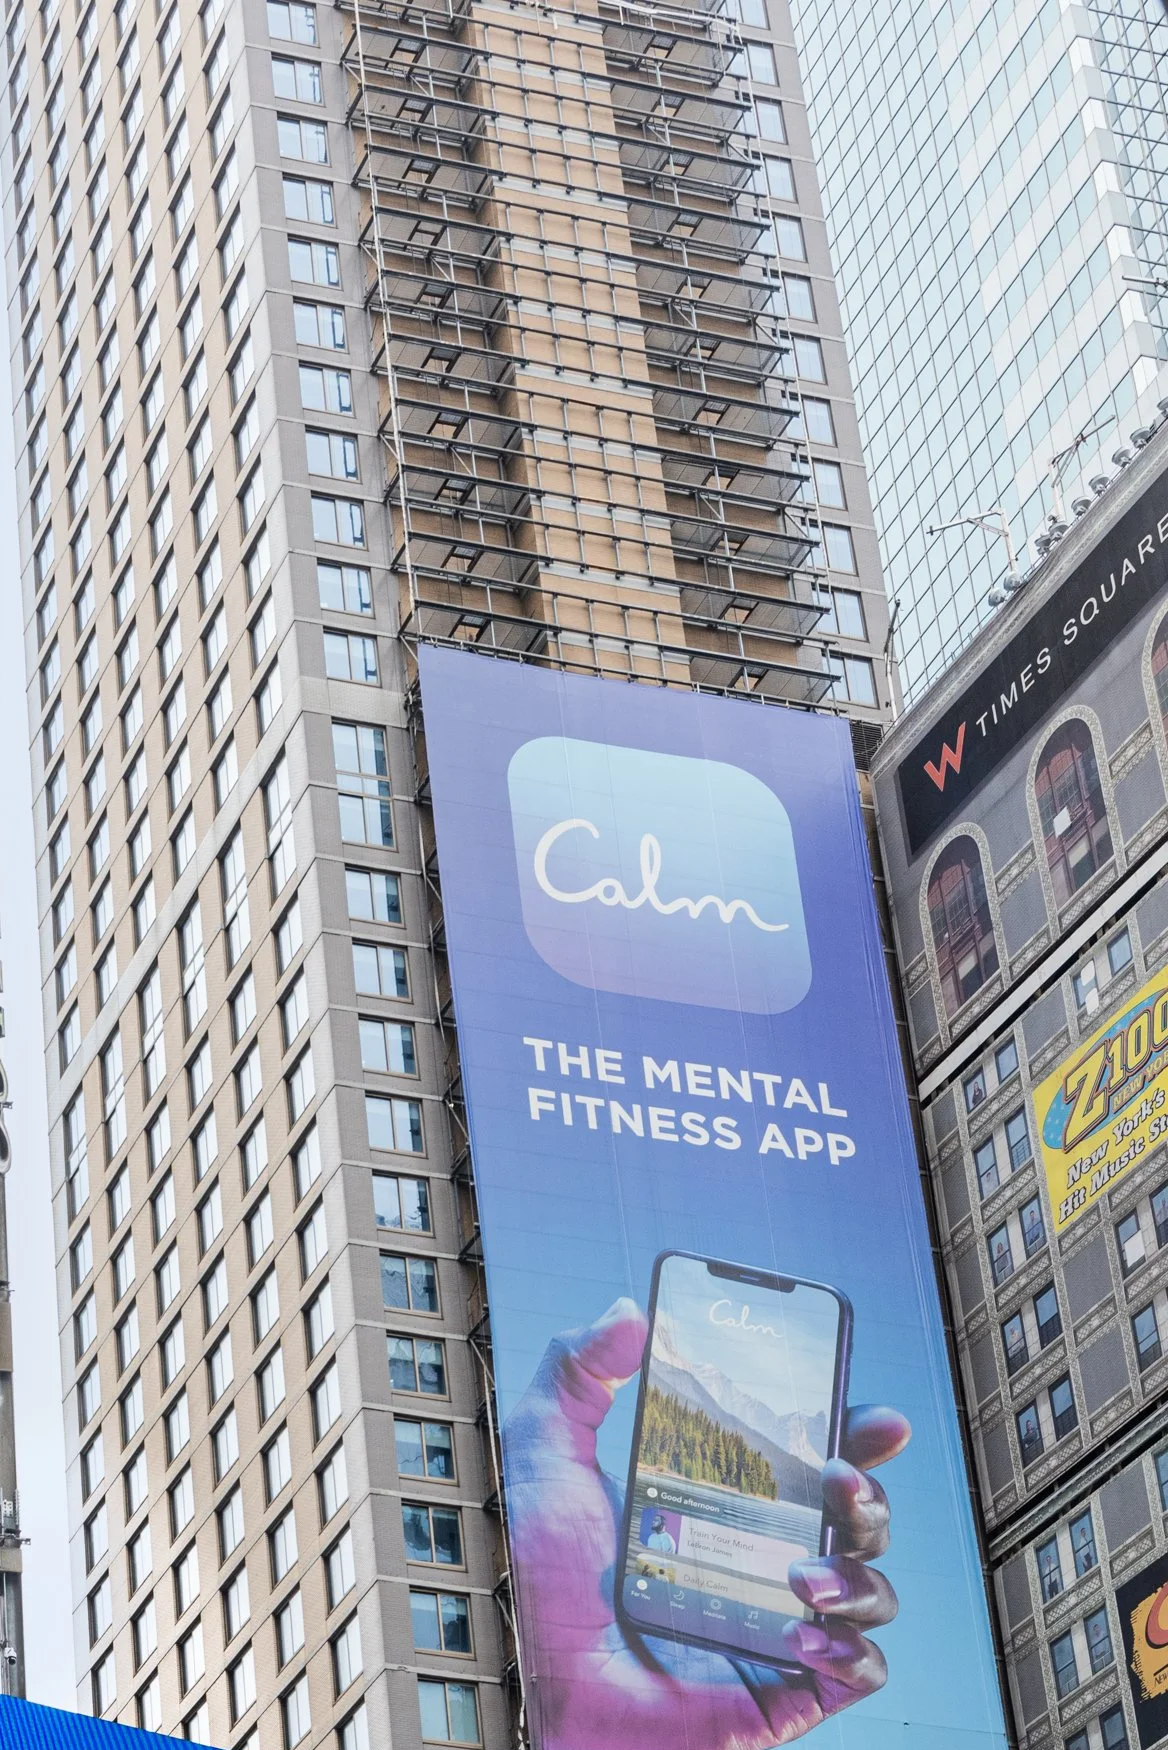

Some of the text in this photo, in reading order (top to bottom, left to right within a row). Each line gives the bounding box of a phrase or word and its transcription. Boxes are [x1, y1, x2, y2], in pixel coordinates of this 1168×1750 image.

[923, 721, 966, 793] W
[975, 648, 1052, 738] TIMES
[534, 818, 789, 932] Calm
[523, 1037, 849, 1118] THE MENTAL
[528, 1086, 857, 1166] FITNESS APP
[1066, 1088, 1166, 1189] New York's
[1059, 1186, 1087, 1224] Hit
[1090, 1137, 1145, 1197] Music
[708, 1298, 785, 1338] Calm
[661, 1492, 720, 1513] Good afternoon
[689, 1527, 754, 1552] Train Your Mind
[683, 1574, 728, 1593] Daily Calm
